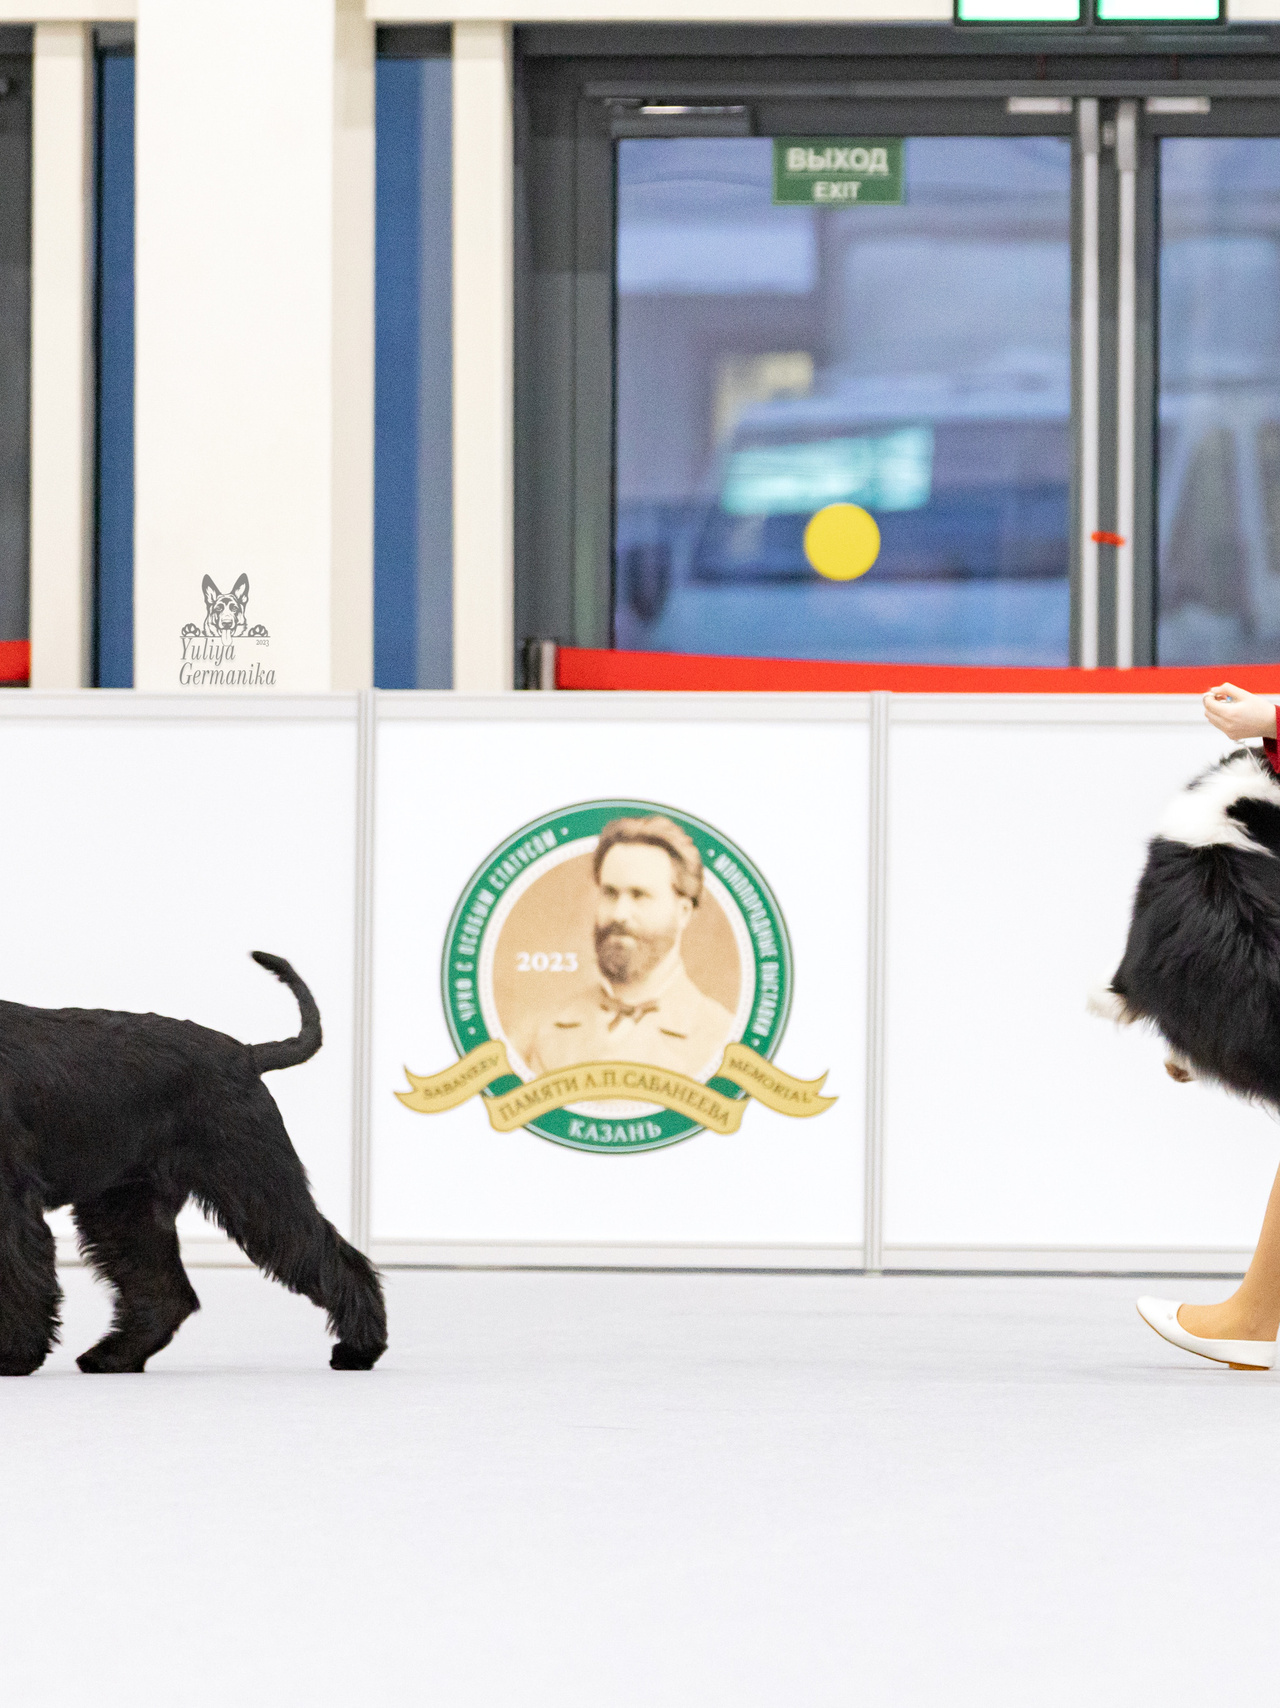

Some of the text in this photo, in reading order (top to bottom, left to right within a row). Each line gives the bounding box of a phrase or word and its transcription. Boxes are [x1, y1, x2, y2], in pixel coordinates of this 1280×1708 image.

[786, 147, 889, 176] ВЫХОД
[812, 181, 862, 202] EXIT
[488, 829, 558, 890] СТАТУСОМ
[516, 951, 579, 973] 2023
[728, 1058, 813, 1104] MEMORIAL
[499, 1074, 579, 1123] ПАМЯТИ
[568, 1119, 662, 1143] КАЗАНЬ
